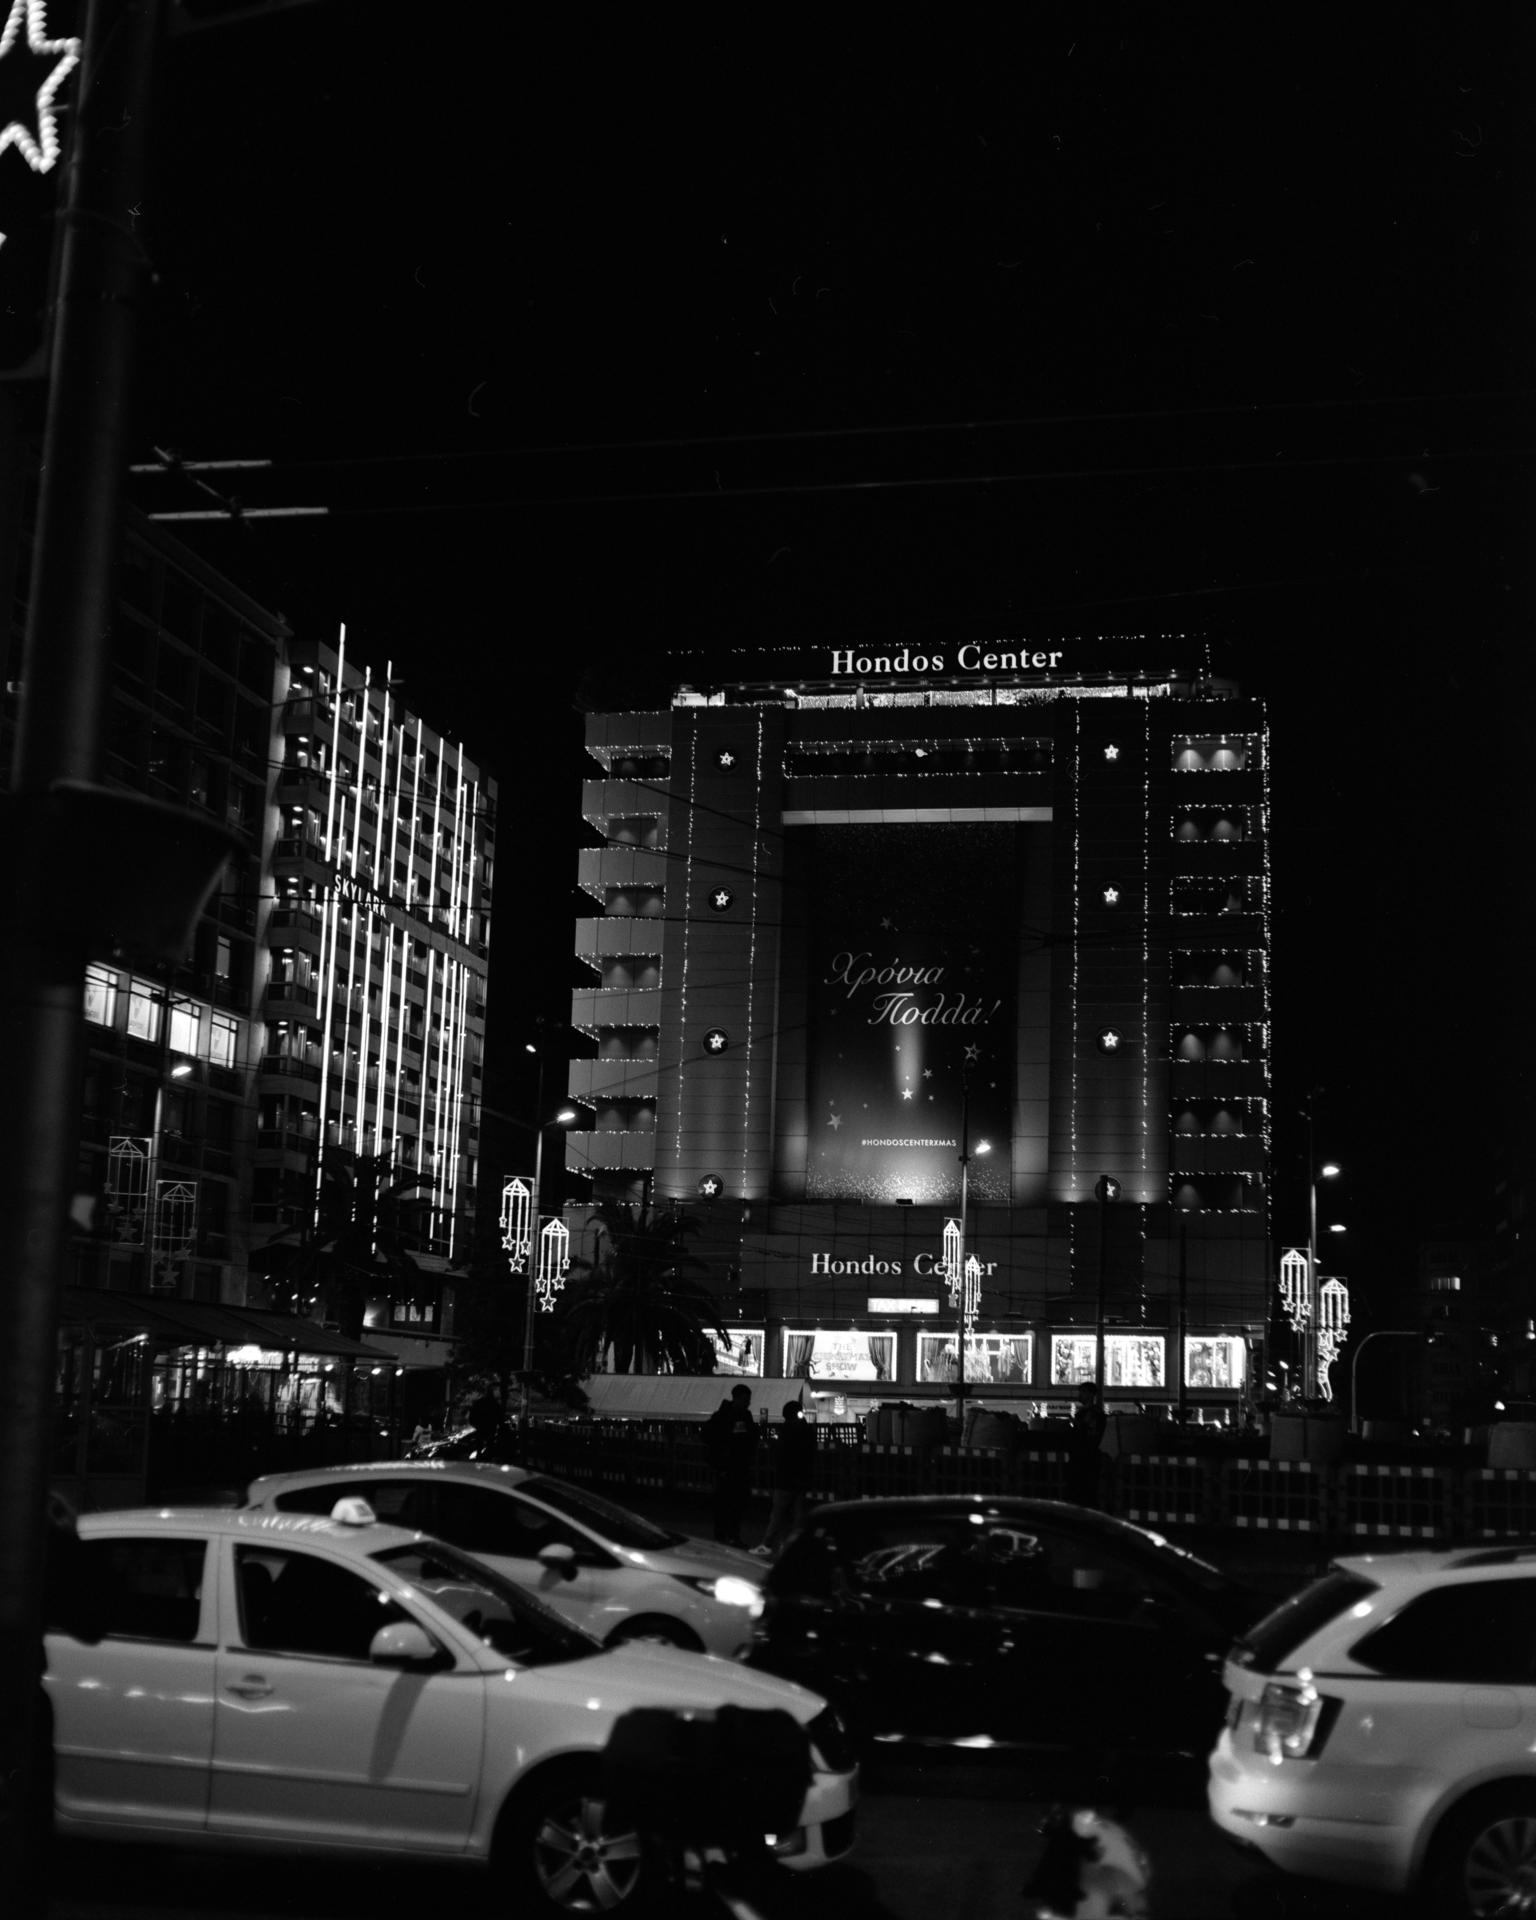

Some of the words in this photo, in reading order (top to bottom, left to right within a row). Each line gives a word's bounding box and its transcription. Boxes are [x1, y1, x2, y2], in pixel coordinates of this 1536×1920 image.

[831, 650, 945, 675] Hondos
[957, 644, 1064, 670] Center
[334, 873, 387, 919] SKYLARK
[824, 951, 944, 999] Χρόνια
[867, 992, 1002, 1025] Πολλά!
[861, 1138, 957, 1148] #HONDOSCENTERXMAS
[811, 1253, 903, 1275] Hondos
[913, 1252, 998, 1276] Ceer
